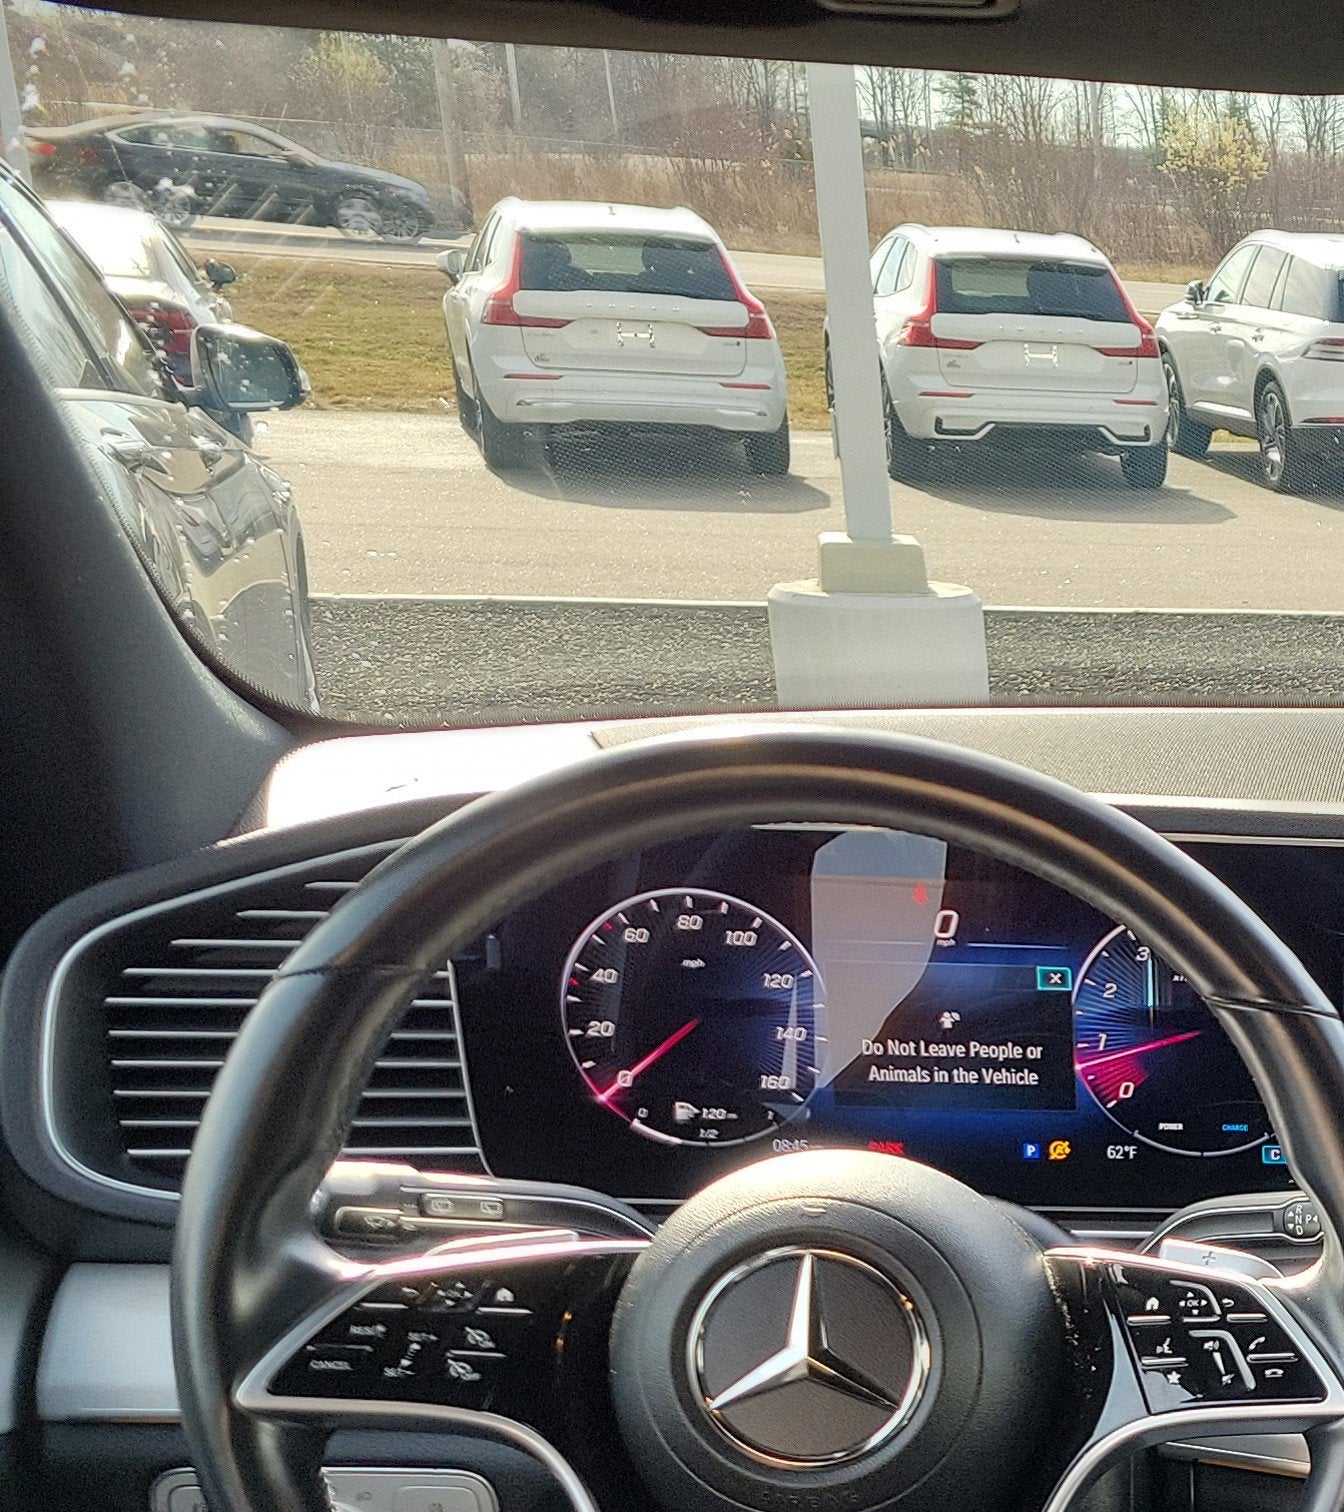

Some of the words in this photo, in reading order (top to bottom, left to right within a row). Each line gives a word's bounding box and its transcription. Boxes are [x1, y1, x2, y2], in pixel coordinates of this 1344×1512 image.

[677, 915, 702, 930] 80
[934, 909, 959, 938] 0
[624, 928, 649, 943] 60
[725, 931, 756, 946] 100
[1136, 947, 1150, 961] 3
[591, 968, 618, 983] 40
[763, 973, 794, 988] 120
[1103, 983, 1118, 998] 2
[587, 1021, 615, 1036] 20
[775, 1027, 807, 1040] 140
[1099, 1033, 1107, 1050] 1
[861, 1039, 884, 1055] Do
[887, 1039, 917, 1056] Not
[920, 1040, 966, 1058] Leave
[970, 1041, 1023, 1061] People
[1027, 1044, 1043, 1059] or
[617, 1070, 634, 1087] 0
[760, 1075, 791, 1089] 160
[868, 1065, 931, 1083] Animals
[934, 1066, 950, 1083] in
[953, 1067, 979, 1084] the
[982, 1067, 1040, 1085] Vehicle
[1119, 1082, 1135, 1099] 0
[702, 1107, 727, 1120] 120
[1025, 1144, 1036, 1158] P
[1107, 1145, 1138, 1160] 62°F
[1270, 1149, 1281, 1161] C
[1296, 1204, 1303, 1214] R
[1295, 1214, 1303, 1224] N
[1305, 1213, 1312, 1225] P
[1295, 1225, 1304, 1236] D
